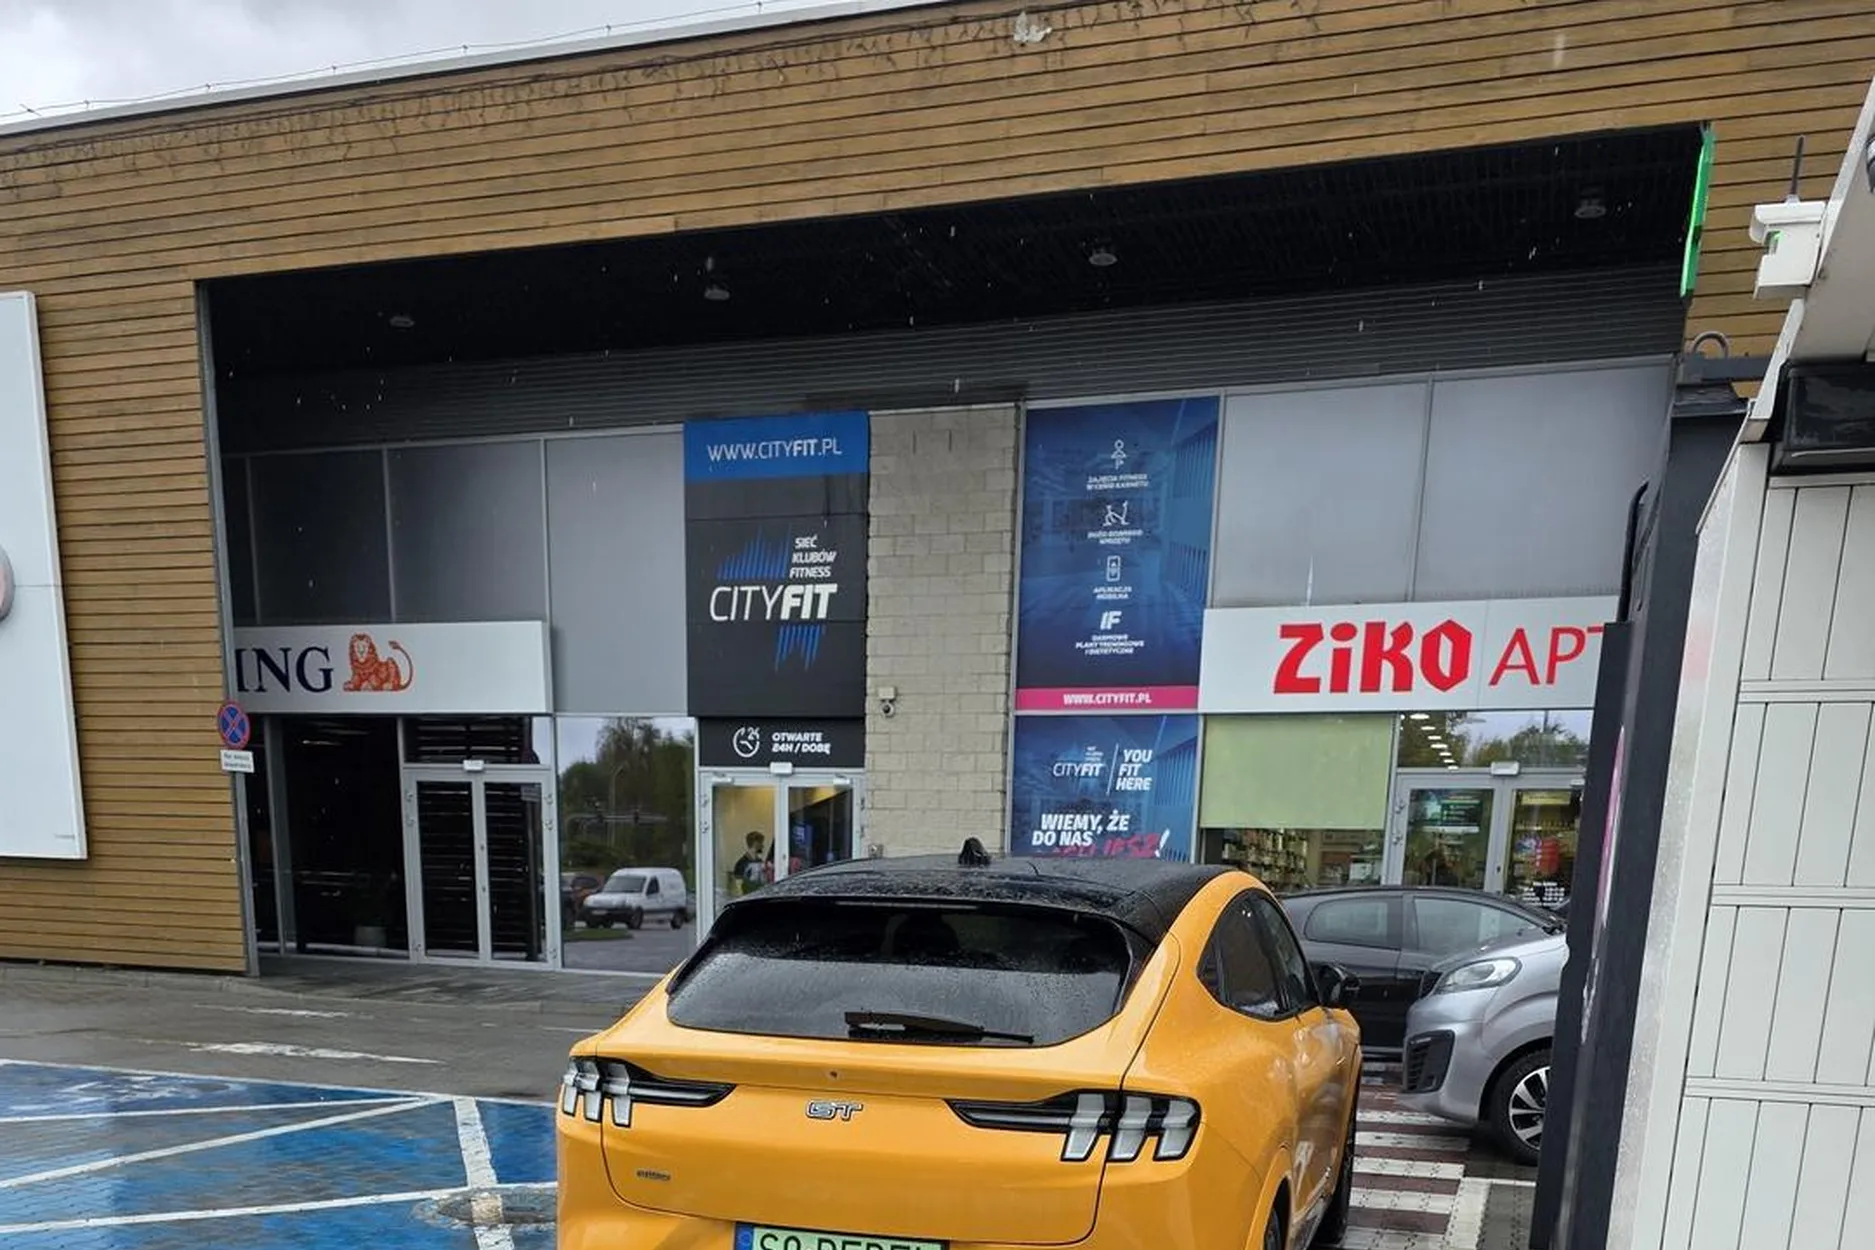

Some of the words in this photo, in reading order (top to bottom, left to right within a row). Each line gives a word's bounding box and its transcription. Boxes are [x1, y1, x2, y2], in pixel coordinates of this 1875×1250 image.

[707, 437, 843, 463] WWW.CITYFIT.PL
[795, 534, 817, 548] SIEĆ
[792, 548, 837, 563] KLUBÓW
[789, 565, 831, 578] FITNESS
[709, 583, 838, 621] CITYFIT
[235, 646, 334, 692] ING
[1063, 692, 1153, 705] WWW.CITYFIT.PL
[771, 732, 823, 742] OTWARTE
[1123, 749, 1153, 763] YOU
[1053, 762, 1105, 777] CITYFIT
[1119, 763, 1142, 776] FIT
[1116, 777, 1153, 790] HERE
[1041, 813, 1103, 834] WIEMY,
[1106, 808, 1131, 831] ŻE
[1032, 830, 1057, 845] DO
[1058, 831, 1094, 847] NAS
[806, 1099, 864, 1122] GT
